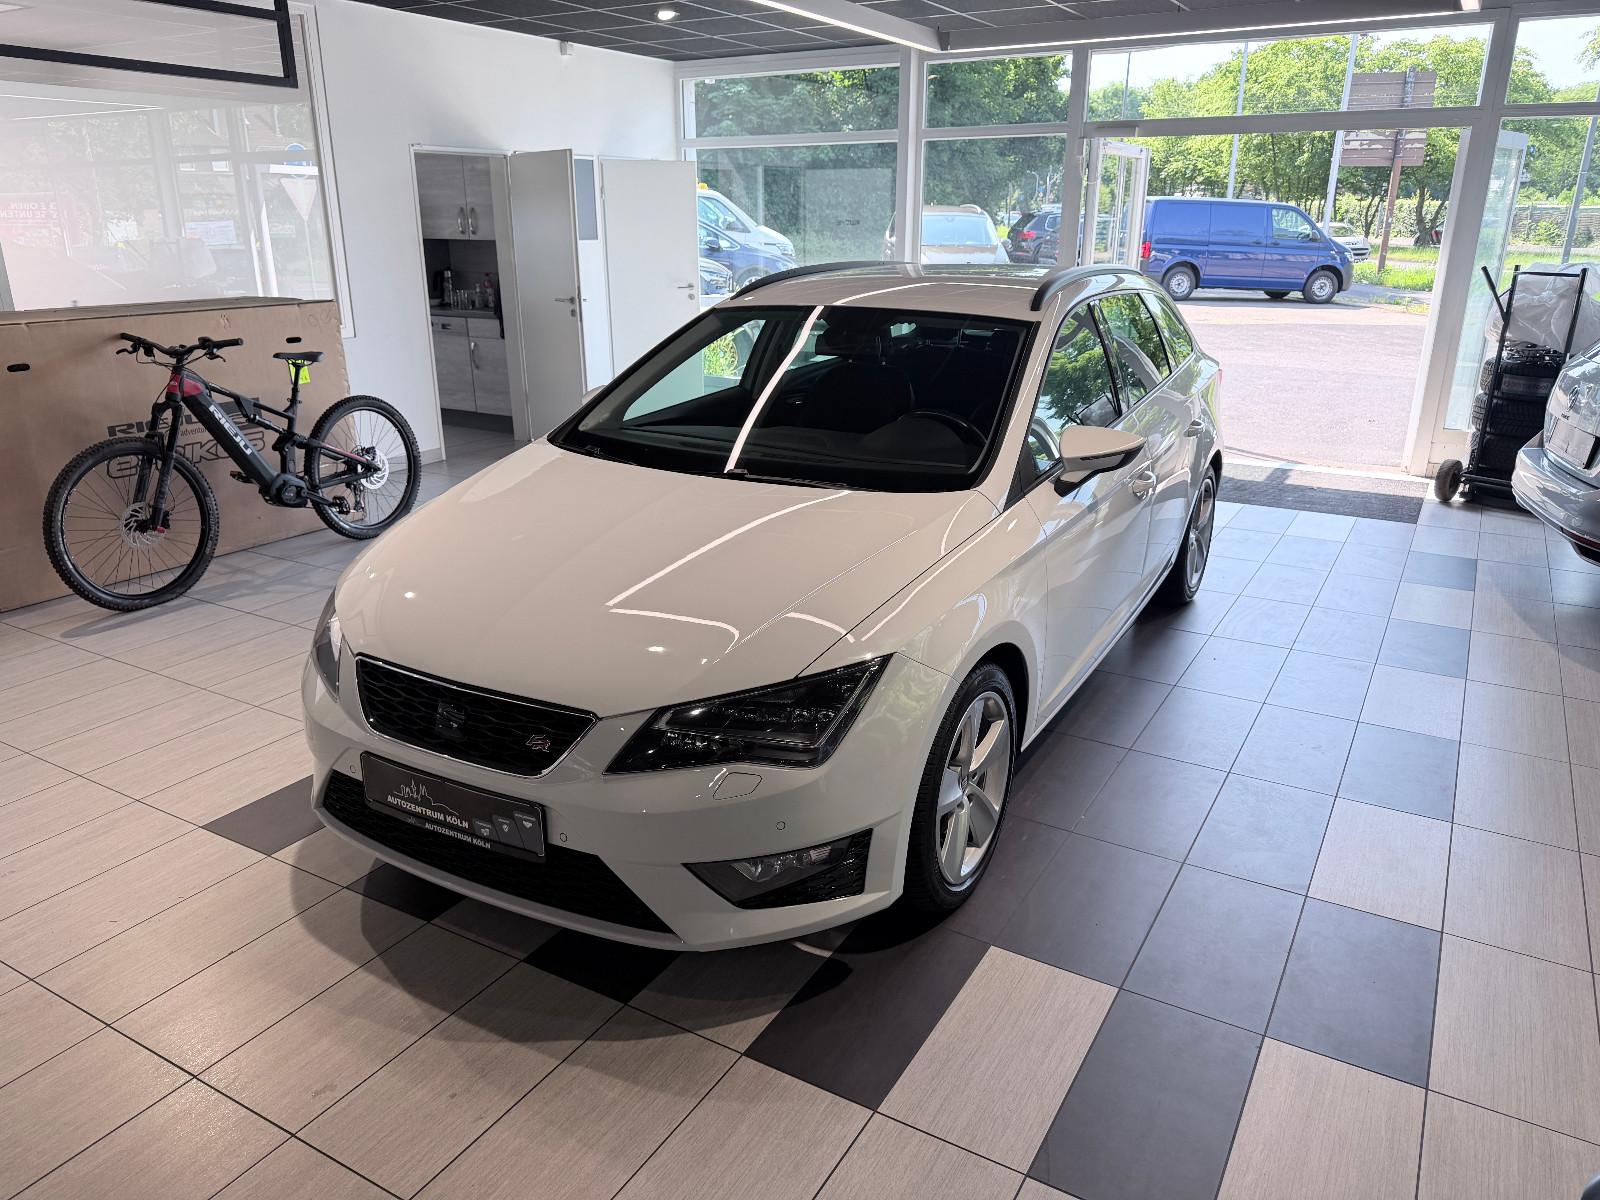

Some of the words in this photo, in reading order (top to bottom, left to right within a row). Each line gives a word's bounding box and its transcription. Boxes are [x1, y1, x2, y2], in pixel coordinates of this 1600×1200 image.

[208, 404, 253, 456] RIEJU
[387, 794, 445, 821] AUTOZENTRUM
[445, 814, 469, 829] KÖLN
[424, 822, 472, 843] AUTOZENTRUM
[472, 837, 491, 849] KÖLN
